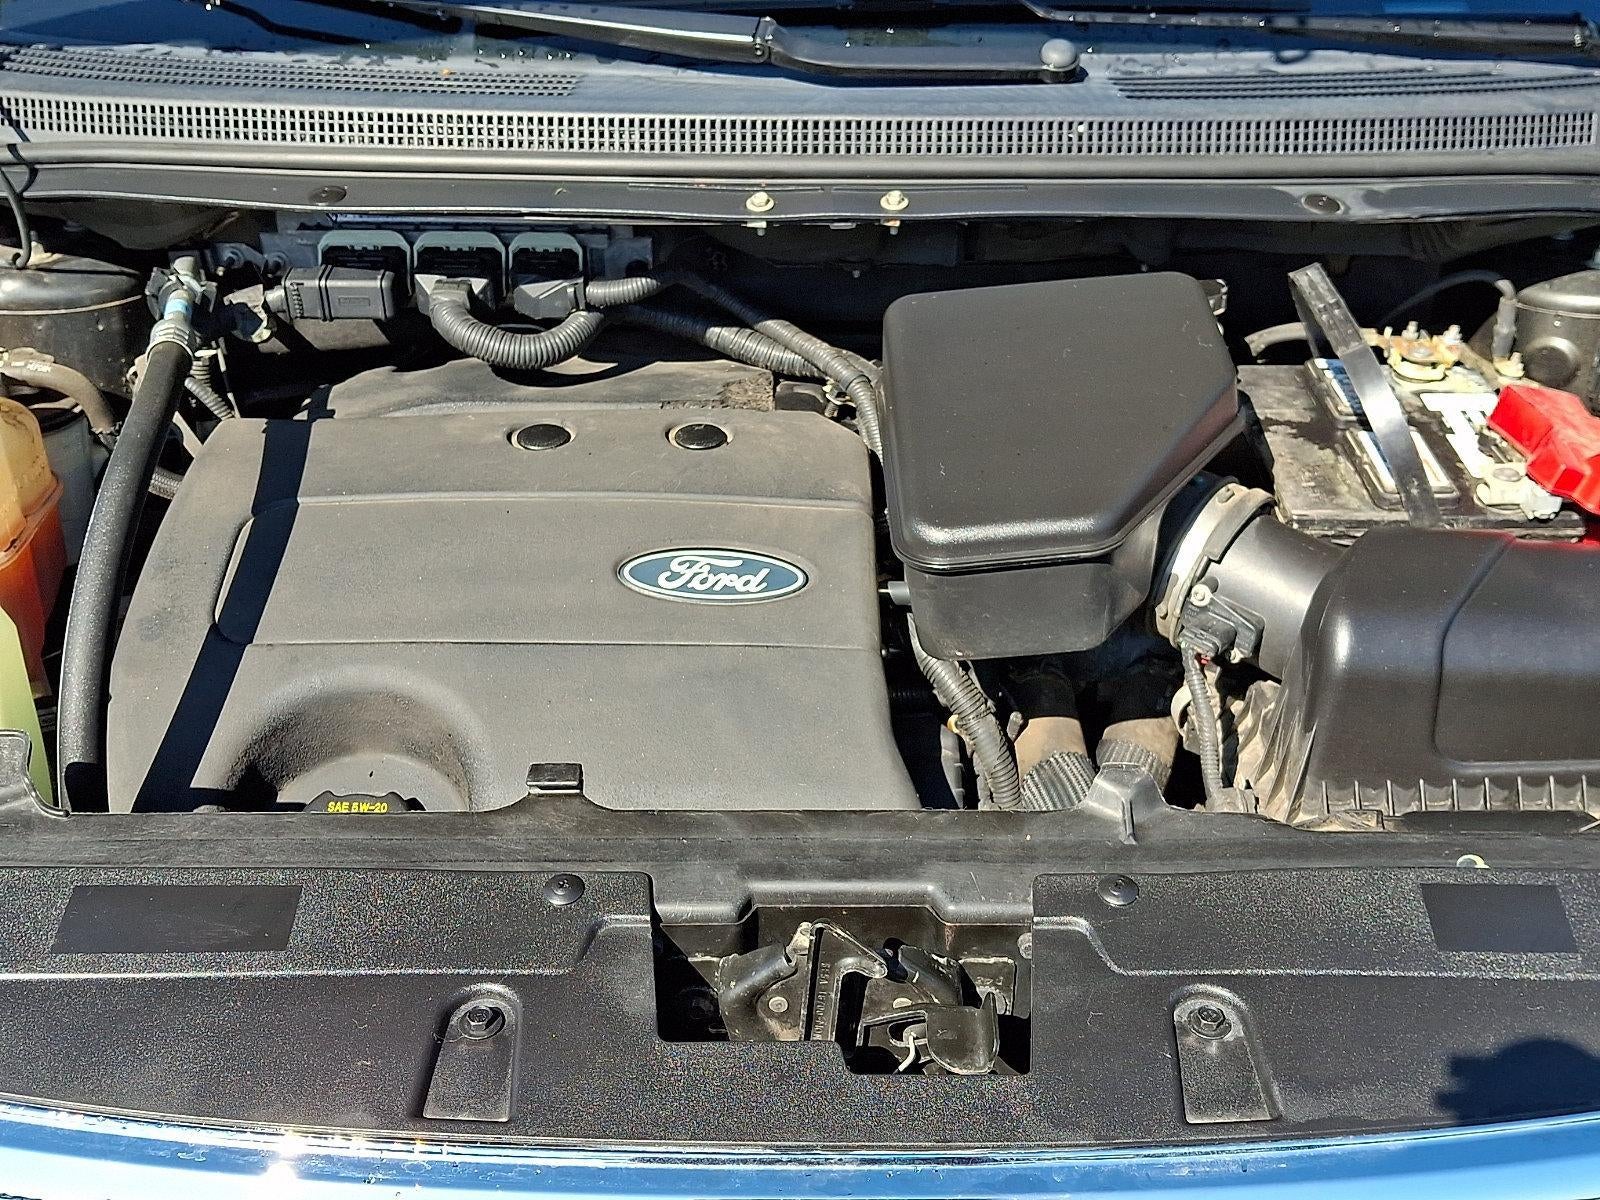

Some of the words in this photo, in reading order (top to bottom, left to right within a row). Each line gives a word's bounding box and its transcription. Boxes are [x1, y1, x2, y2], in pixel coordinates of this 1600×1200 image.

[657, 555, 771, 592] Ford
[327, 801, 350, 813] SAE
[351, 802, 388, 813] 5W-20
